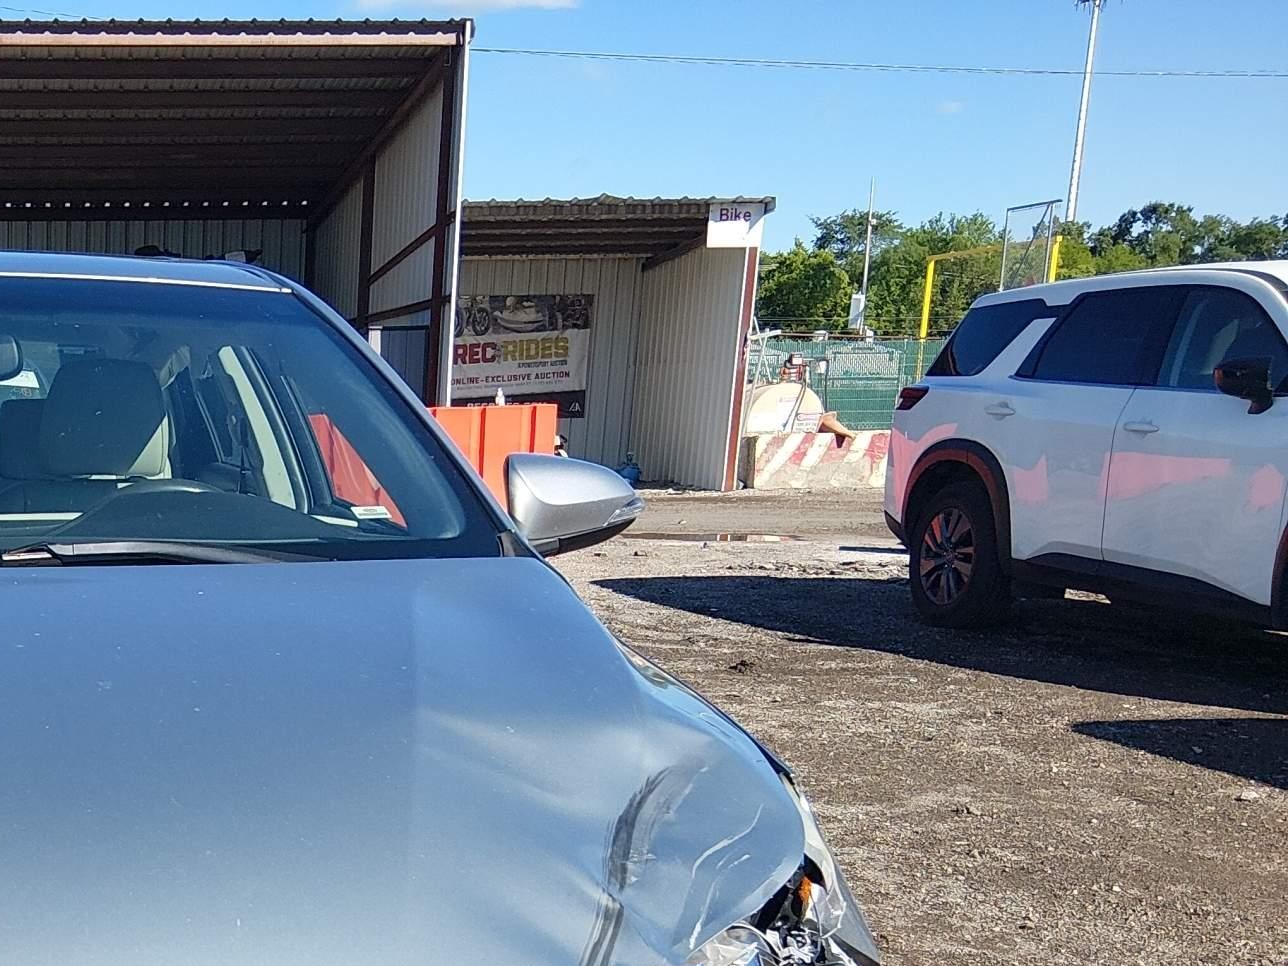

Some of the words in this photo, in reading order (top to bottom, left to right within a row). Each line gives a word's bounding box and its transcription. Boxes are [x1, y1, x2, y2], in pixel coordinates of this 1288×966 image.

[719, 207, 752, 222] Bike
[453, 341, 497, 366] REC
[502, 335, 569, 362] RIDES
[451, 371, 532, 387] ONLINE-EXCLUSIVE
[534, 370, 571, 381] AUCTION
